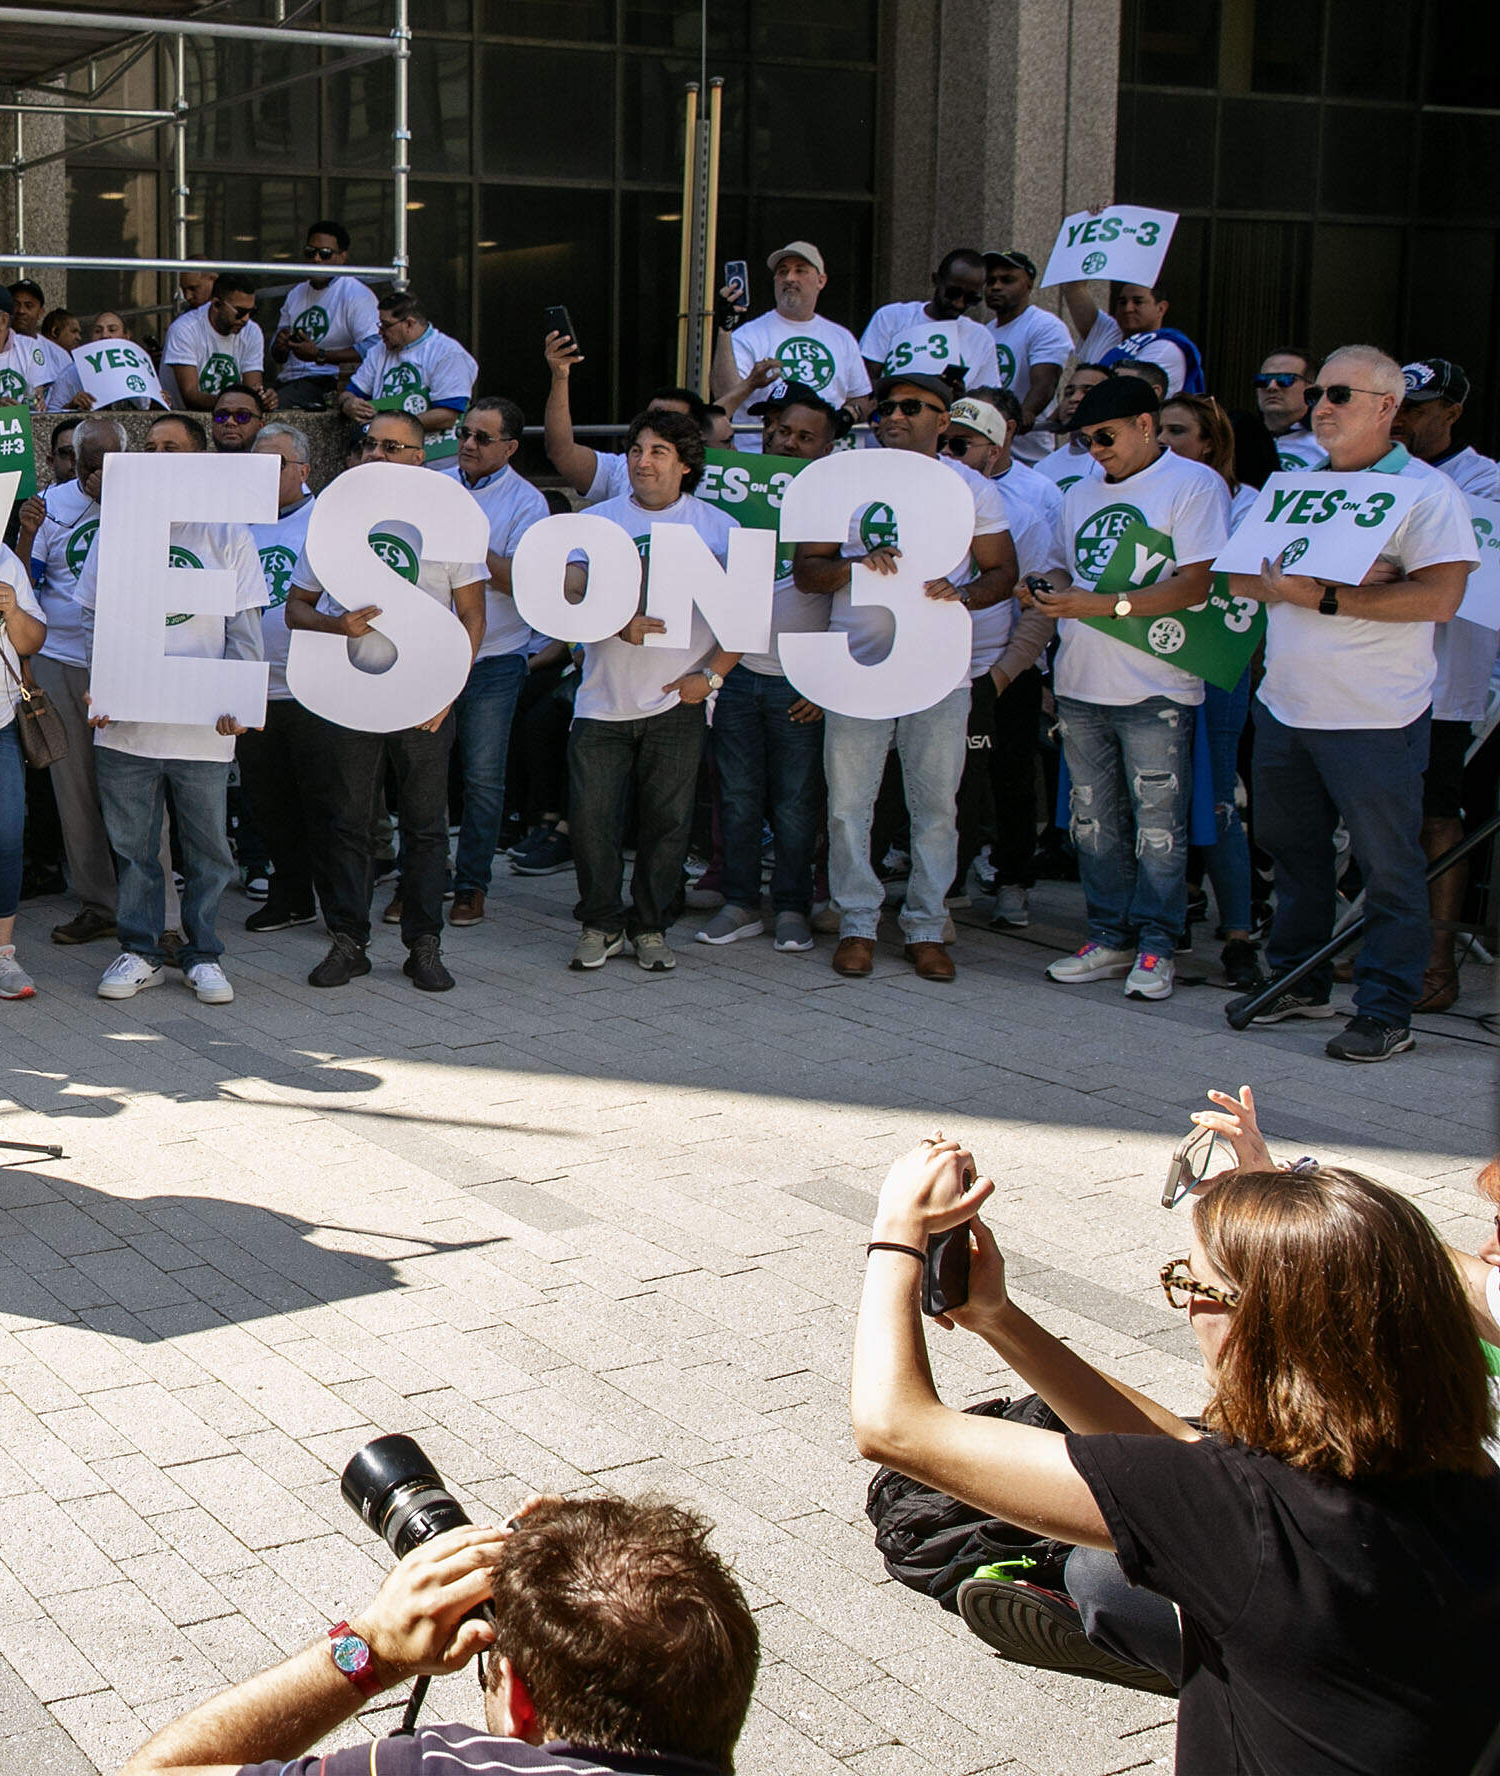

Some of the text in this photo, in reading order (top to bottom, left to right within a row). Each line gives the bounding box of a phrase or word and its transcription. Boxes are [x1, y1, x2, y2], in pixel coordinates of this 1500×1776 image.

[1067, 217, 1161, 248] YES ON 3
[84, 348, 140, 374] YES
[788, 344, 820, 360] YES
[884, 334, 949, 377] ES ON 3
[798, 360, 815, 381] 3
[0, 419, 23, 436] LA
[0, 438, 26, 455] #3
[698, 465, 794, 509] ES ON 3
[1265, 489, 1396, 528] YES ON 3
[370, 544, 400, 567] ES
[511, 513, 777, 654] ON
[778, 448, 976, 720] 3
[1211, 595, 1260, 633] ON 3
